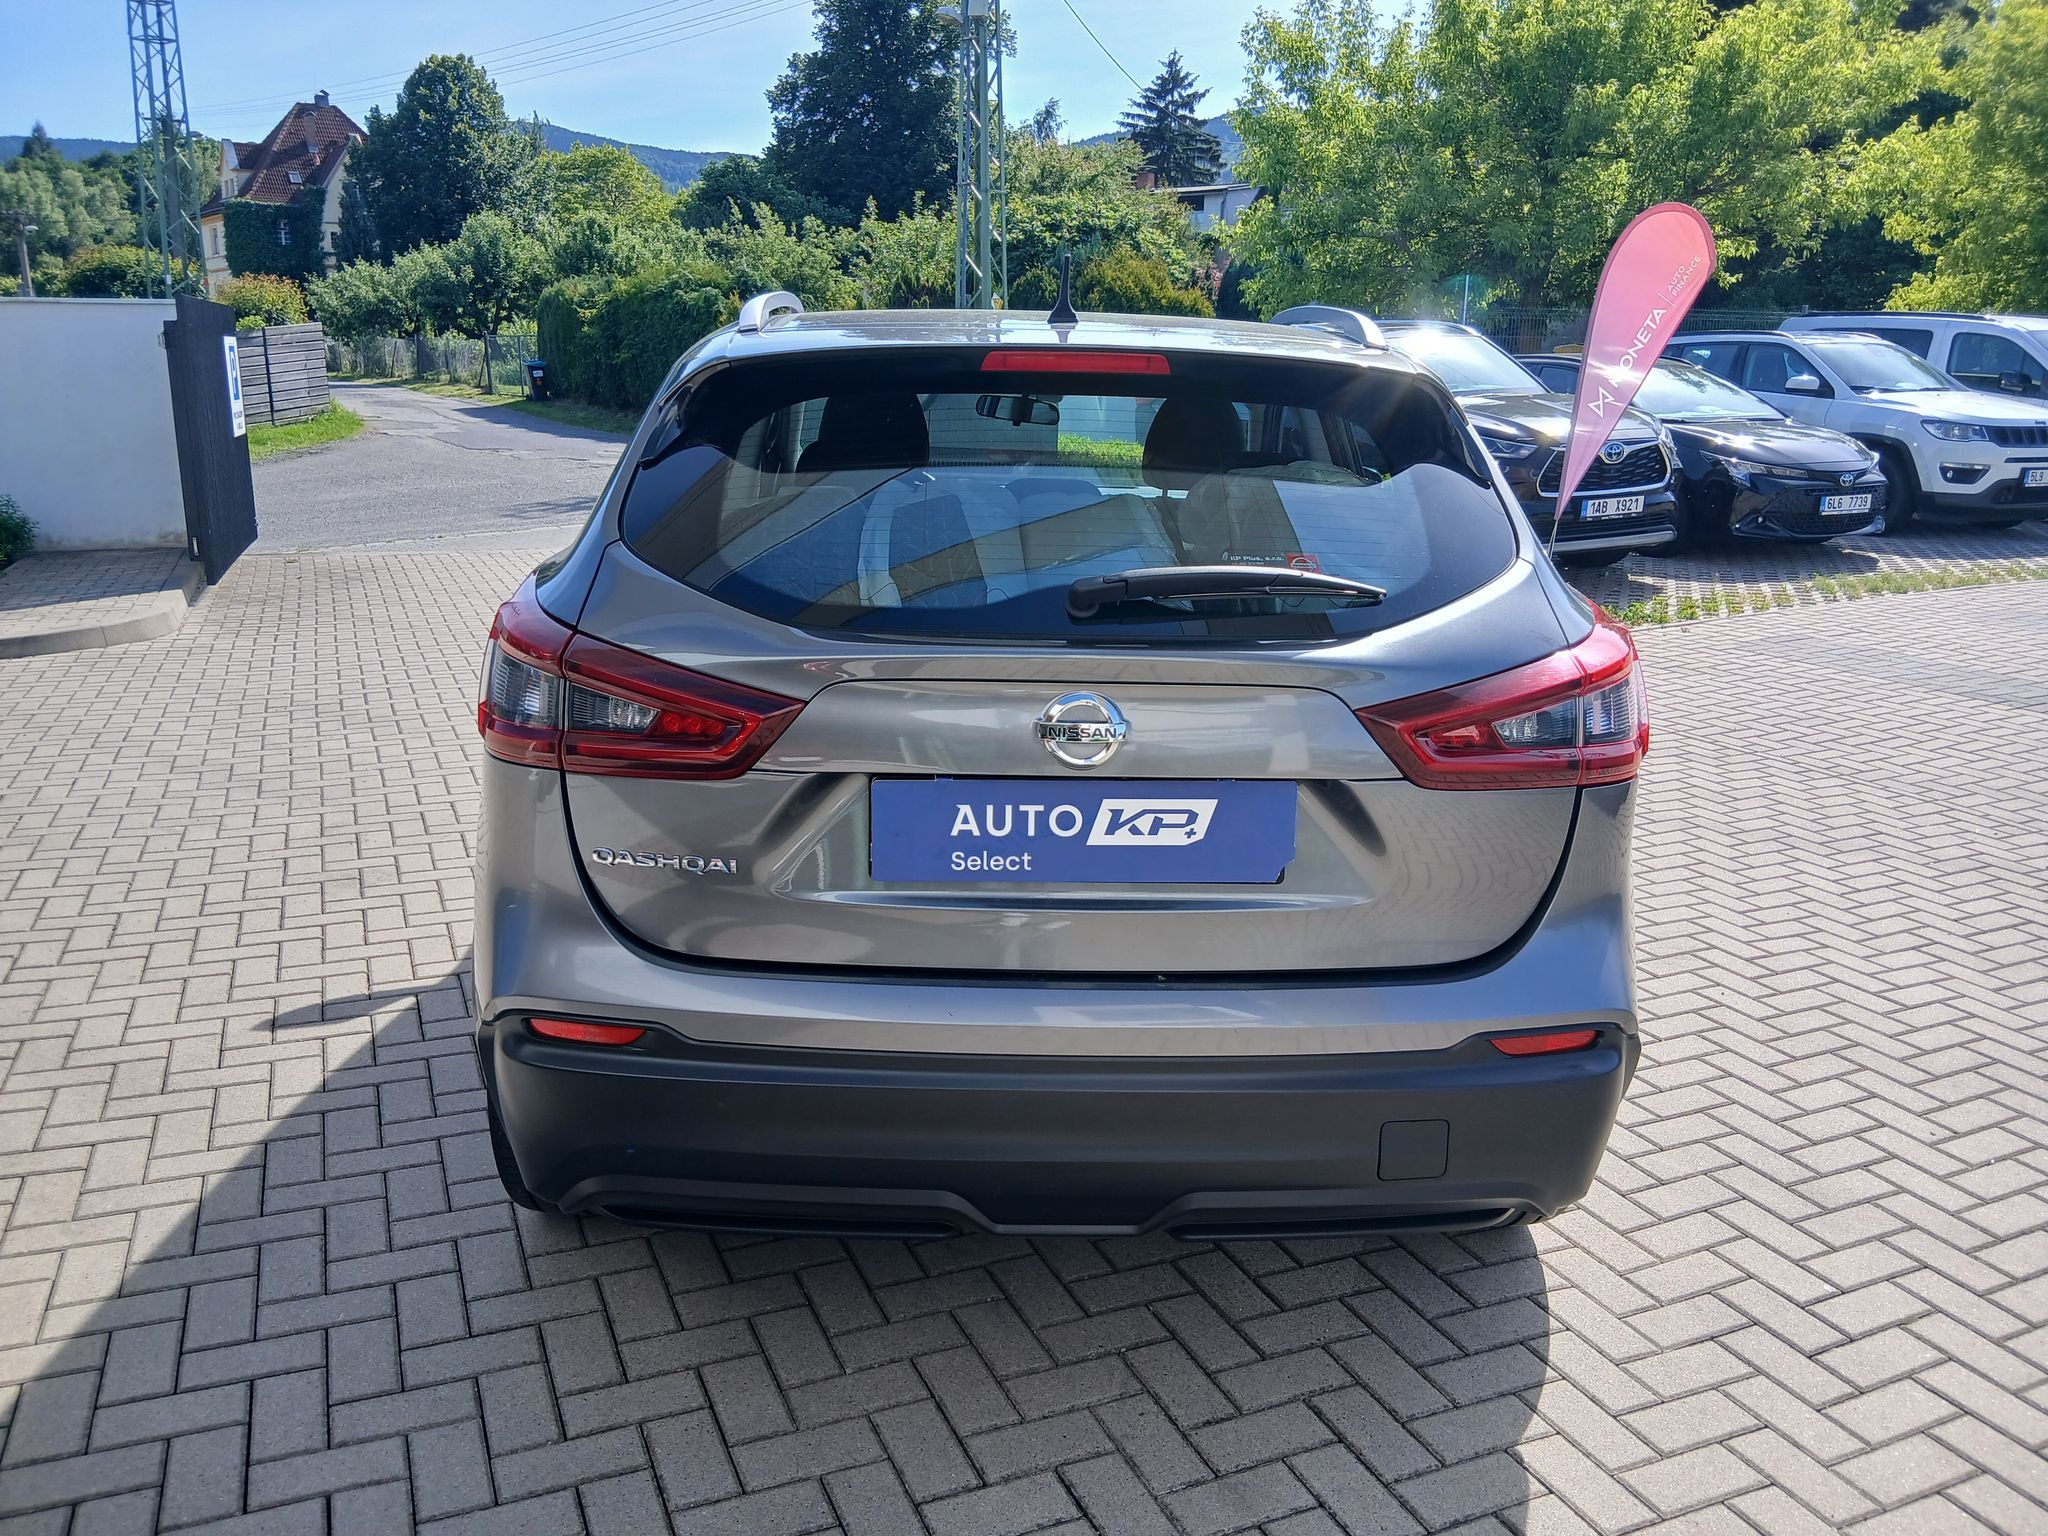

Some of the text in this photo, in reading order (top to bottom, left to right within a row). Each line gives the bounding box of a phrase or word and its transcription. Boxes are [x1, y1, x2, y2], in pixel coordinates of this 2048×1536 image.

[1668, 265, 1686, 292] AUTO
[1671, 255, 1701, 297] FINANCE
[1607, 308, 1667, 388] ONETA
[2030, 471, 2044, 482] 5L9
[1590, 498, 1639, 515] 1AB X921
[1827, 495, 1868, 510] 6L6 7739
[1048, 727, 1117, 739] NISSAN
[950, 804, 1083, 837] AUTO
[592, 847, 737, 875] QASHQAI
[950, 851, 1032, 871] Select
